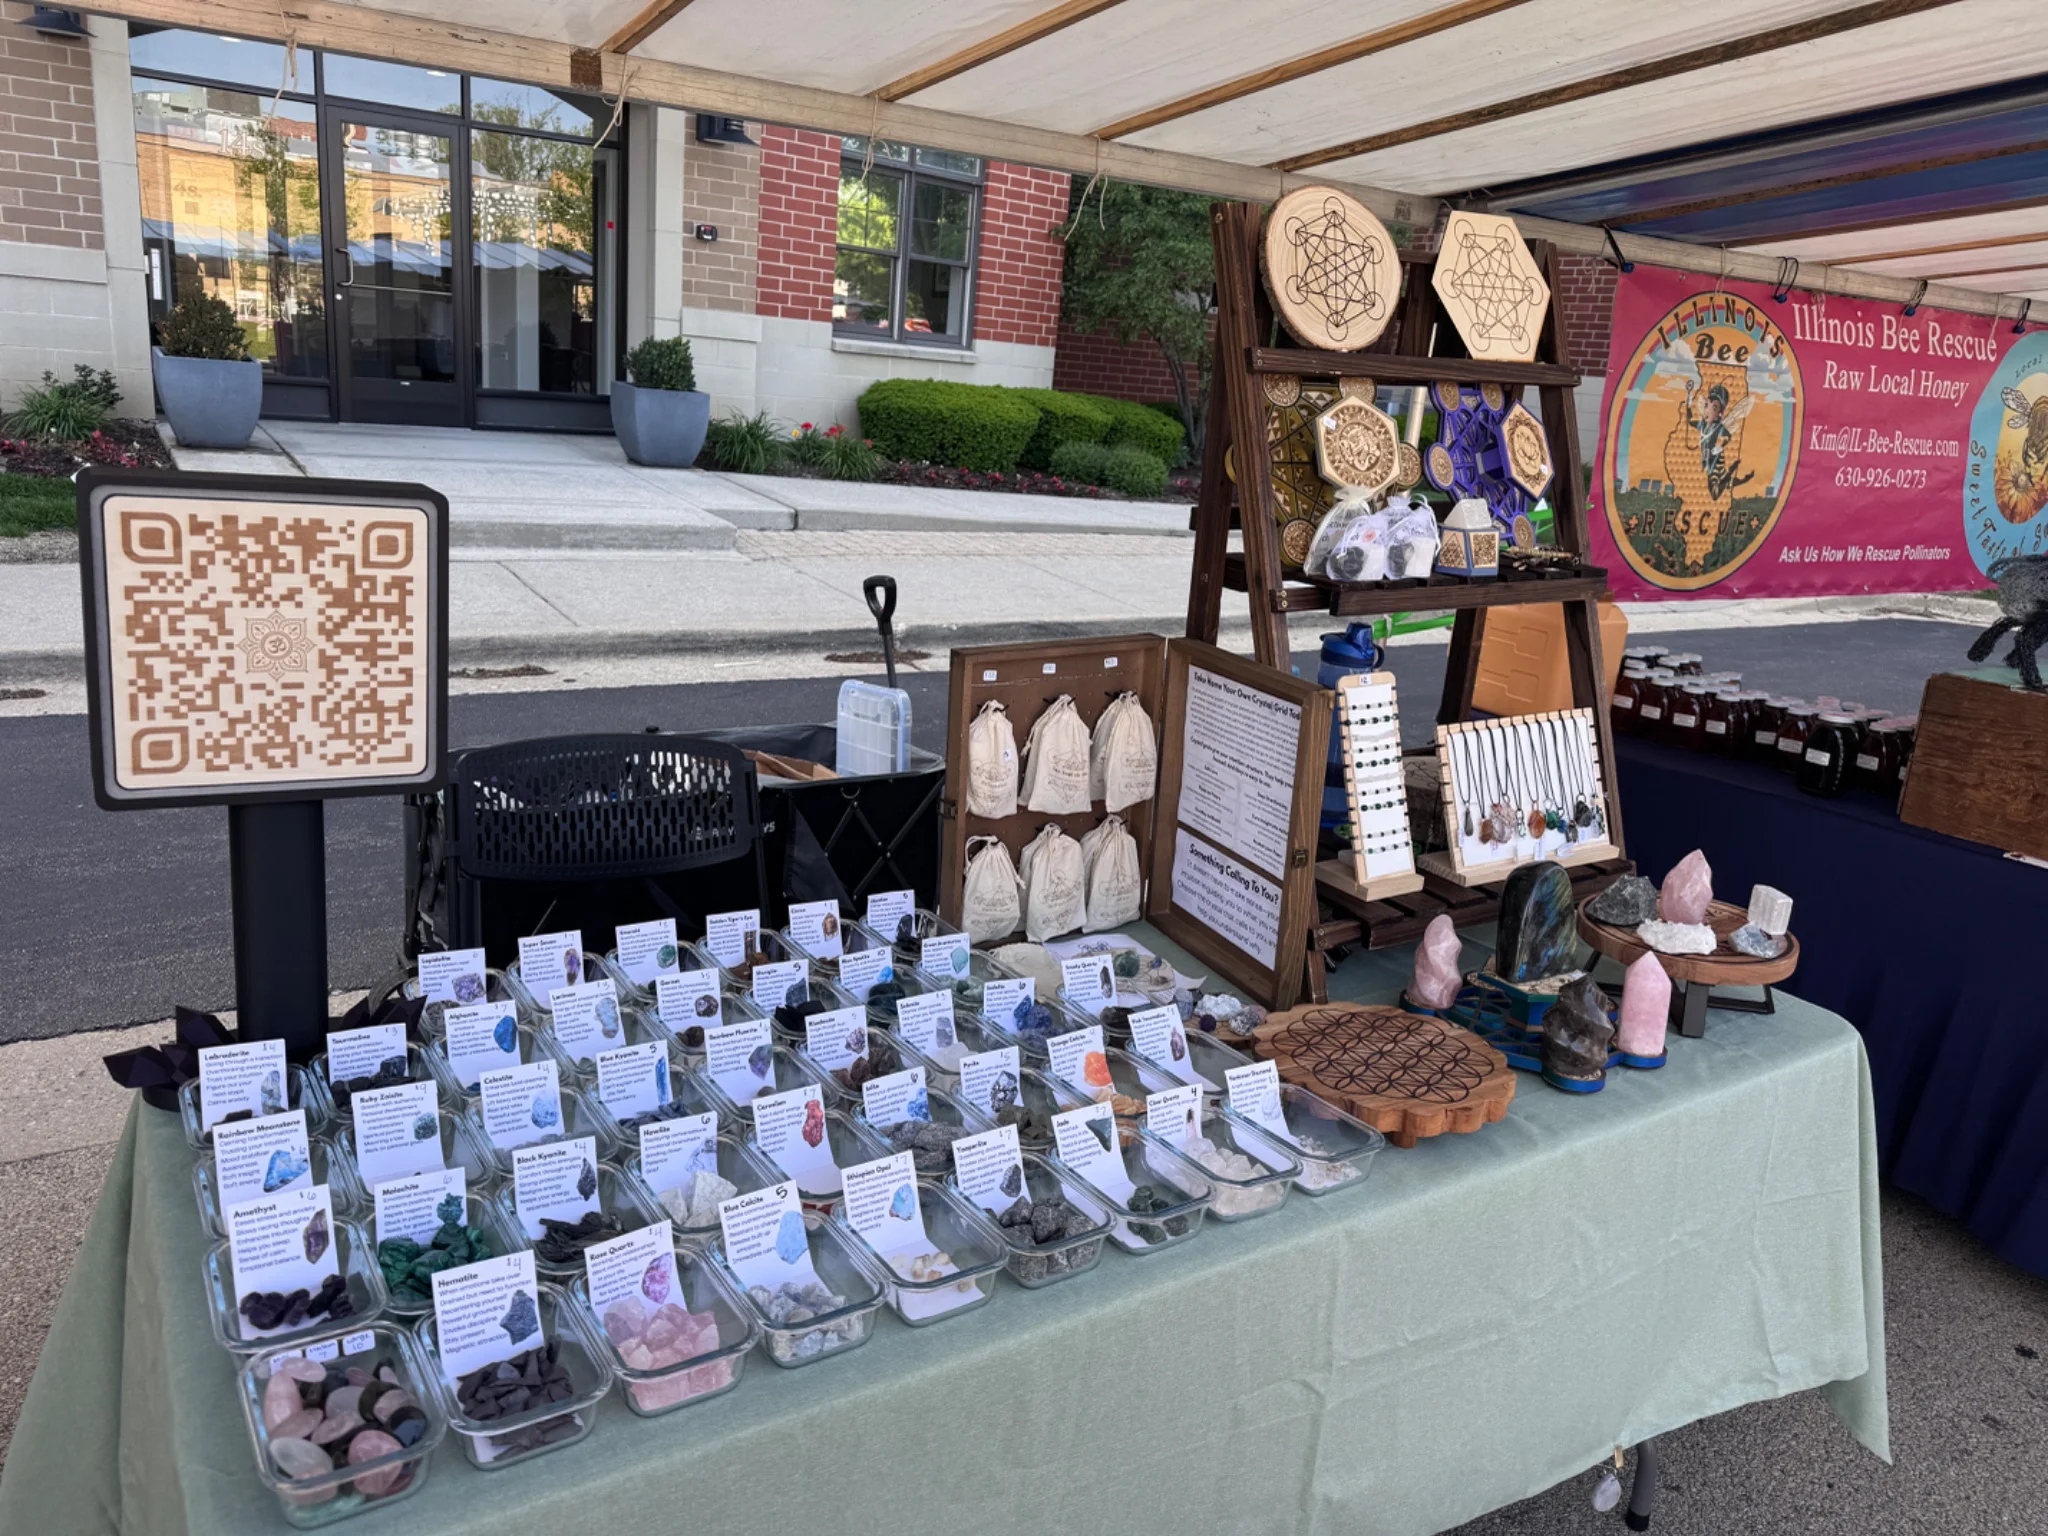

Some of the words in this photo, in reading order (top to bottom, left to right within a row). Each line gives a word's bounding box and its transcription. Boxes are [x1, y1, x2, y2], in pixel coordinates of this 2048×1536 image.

[1657, 296, 1785, 358] ILLINOIS
[1792, 303, 1875, 349] Illinois
[1881, 314, 1920, 354] Bee
[1927, 320, 1998, 362] Rescue
[1694, 333, 1749, 363] Bee
[2015, 353, 2043, 378] Local
[1823, 360, 1865, 391] Raw
[1868, 365, 1915, 397] Local
[1918, 370, 1969, 407] Honey
[1809, 425, 1960, 459] Kim@IL-Bee-Rescue.com
[1835, 466, 1928, 489] 630-926-0273
[1641, 509, 1750, 537] RESCUE
[1778, 547, 1801, 563] Ask
[1803, 547, 1818, 563] Us
[1820, 546, 1846, 562] How
[1847, 546, 1863, 561] We
[1865, 546, 1901, 561] Rescue
[1902, 543, 1951, 560] Pollinators
[1193, 671, 1206, 685] Take
[1206, 677, 1222, 691] Home
[1222, 682, 1237, 695] Your
[1237, 688, 1251, 701] Own
[1251, 694, 1273, 710] Crystal
[1273, 702, 1288, 715] Grid
[1288, 707, 1301, 720] Tod
[1189, 842, 1224, 876] Something
[1225, 865, 1250, 891] Calling
[1251, 880, 1260, 894] To
[1261, 885, 1279, 905] You?
[1224, 882, 1230, 892] to
[1230, 887, 1246, 901] make
[1177, 879, 1197, 898] Choose
[1223, 908, 1235, 921] that
[1235, 918, 1249, 931] calls
[1248, 925, 1256, 935] to
[1225, 899, 1236, 910] you
[1235, 903, 1243, 913] to
[1243, 909, 1257, 923] what
[1258, 919, 1268, 931] you
[1219, 921, 1249, 945] understand
[522, 941, 539, 949] Super
[204, 1050, 250, 1062] Labradorite
[614, 1050, 639, 1060] Kyanite
[649, 1043, 658, 1054] 5
[483, 1074, 513, 1085] Celestite
[359, 1096, 378, 1104] Ruby
[1190, 1086, 1198, 1097] 4
[1148, 1099, 1162, 1107] Clear
[1162, 1094, 1180, 1104] Quartz
[700, 1115, 711, 1125] 6
[1056, 1119, 1070, 1128] Jade
[217, 1128, 255, 1140] Rainbow
[256, 1119, 301, 1132] Moonstone
[643, 1126, 671, 1137] Howlite
[517, 1154, 537, 1165] Black
[537, 1149, 567, 1160] Kyanite
[846, 1168, 876, 1181] Ethiopian
[875, 1163, 892, 1173] Opal
[382, 1183, 420, 1196] Malachite
[775, 1185, 788, 1200] 5
[233, 1204, 277, 1219] Amethyst
[277, 1210, 292, 1218] and
[292, 1205, 317, 1215] anxiety
[723, 1204, 739, 1213] Blue
[739, 1196, 764, 1208] Calcite
[257, 1222, 280, 1233] racing
[279, 1215, 311, 1227] thoughts
[258, 1242, 271, 1251] you
[271, 1239, 291, 1248] sleep
[589, 1251, 608, 1261] Rose
[608, 1241, 635, 1255] Quartz
[438, 1272, 479, 1288] Hematite
